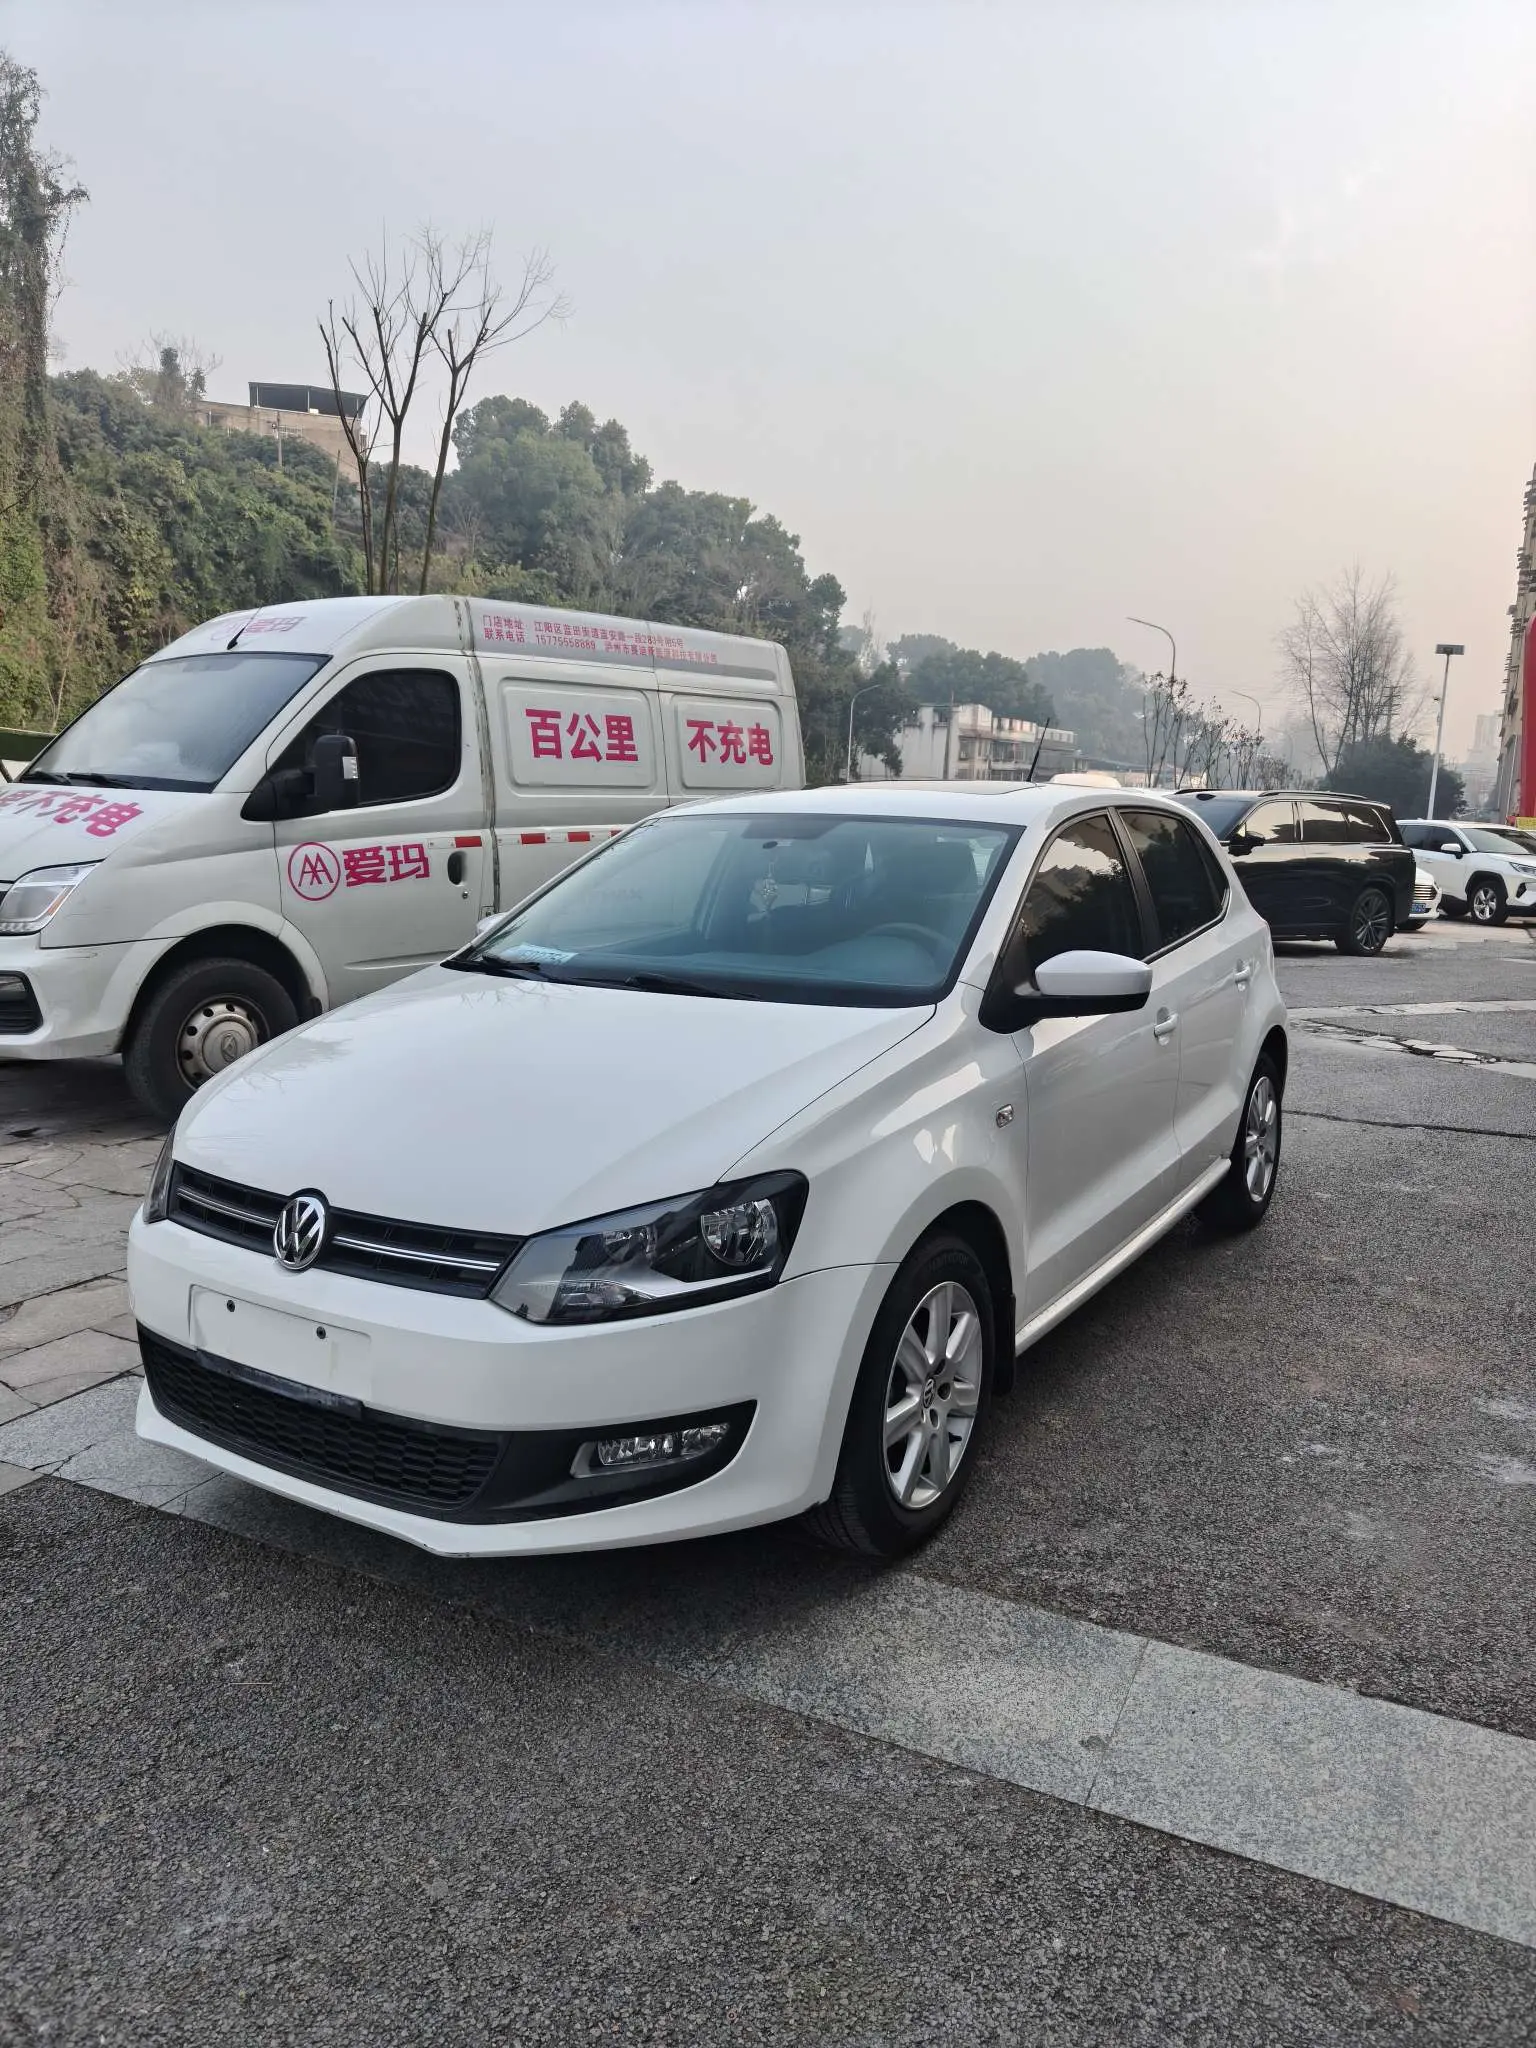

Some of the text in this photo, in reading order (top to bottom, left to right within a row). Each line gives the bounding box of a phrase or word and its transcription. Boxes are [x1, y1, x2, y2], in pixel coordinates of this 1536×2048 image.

[483, 615, 525, 630] 门店地址
[484, 627, 526, 644] 联系电话
[525, 708, 774, 767] 百公里 不充电
[342, 843, 430, 887] 爱玛
